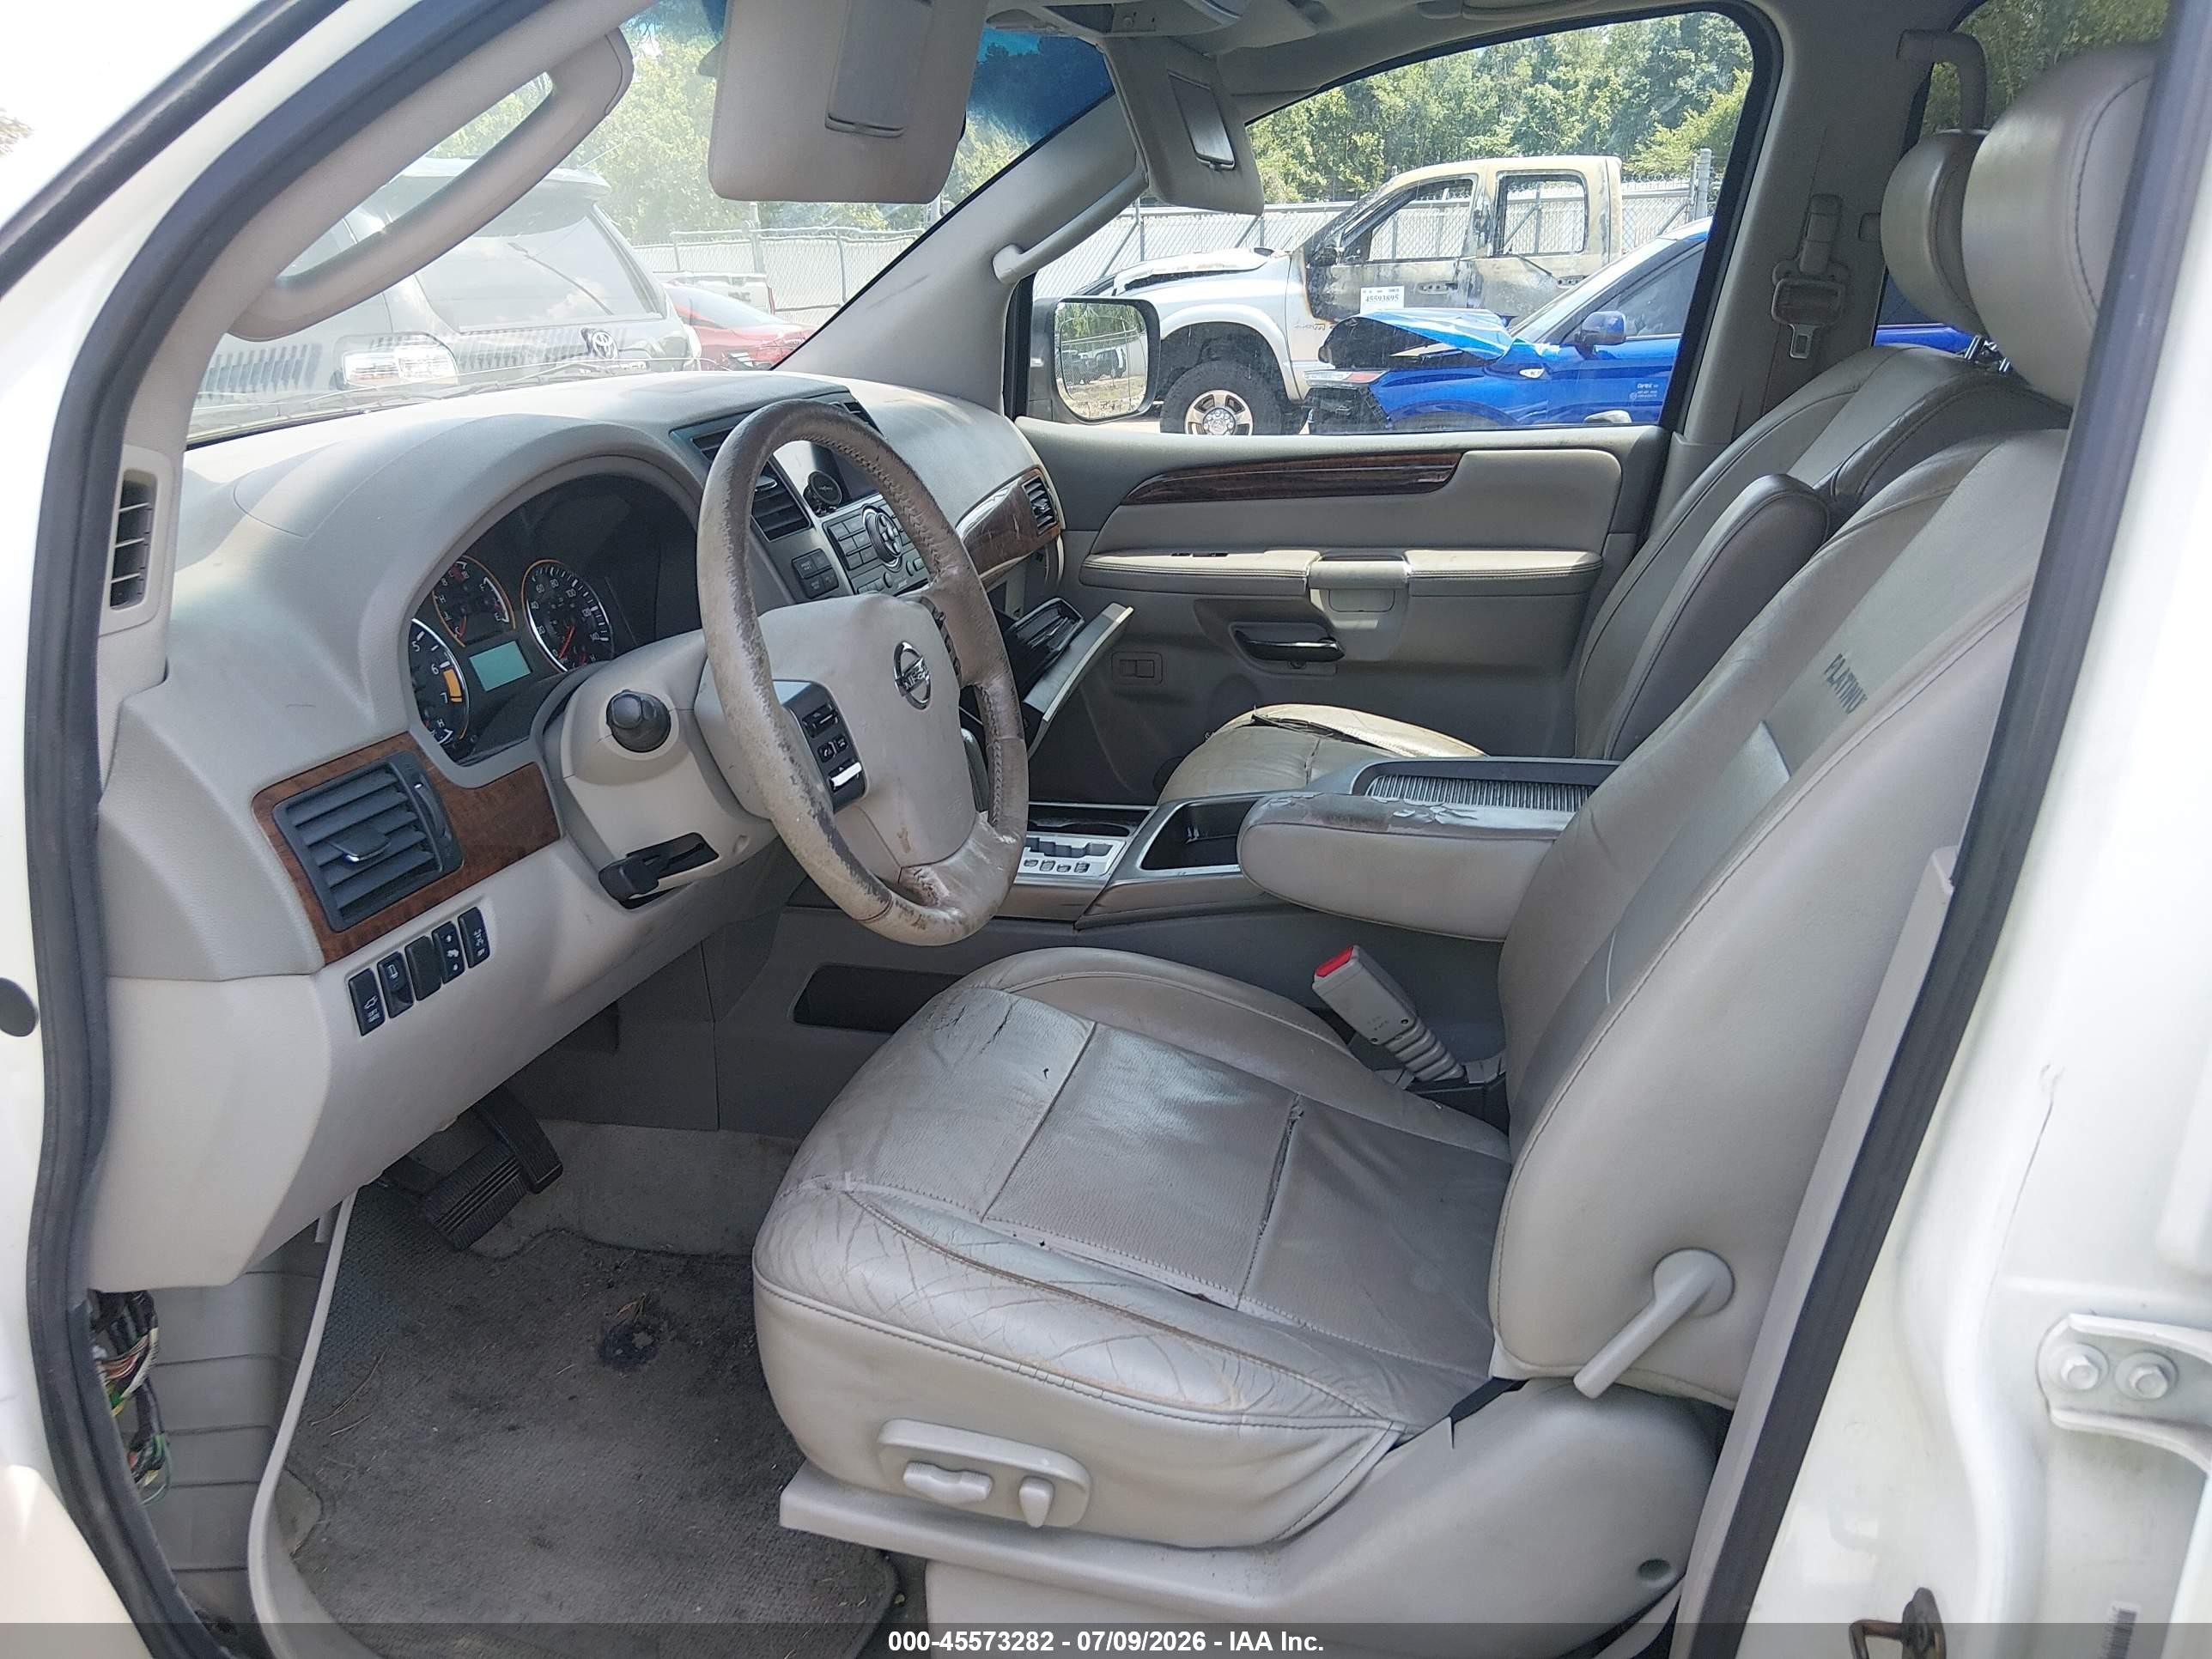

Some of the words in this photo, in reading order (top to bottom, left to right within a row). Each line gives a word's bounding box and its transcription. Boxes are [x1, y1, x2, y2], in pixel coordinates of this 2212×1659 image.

[412, 641, 420, 652] 5
[431, 664, 440, 675] 6
[441, 692, 448, 703] 7
